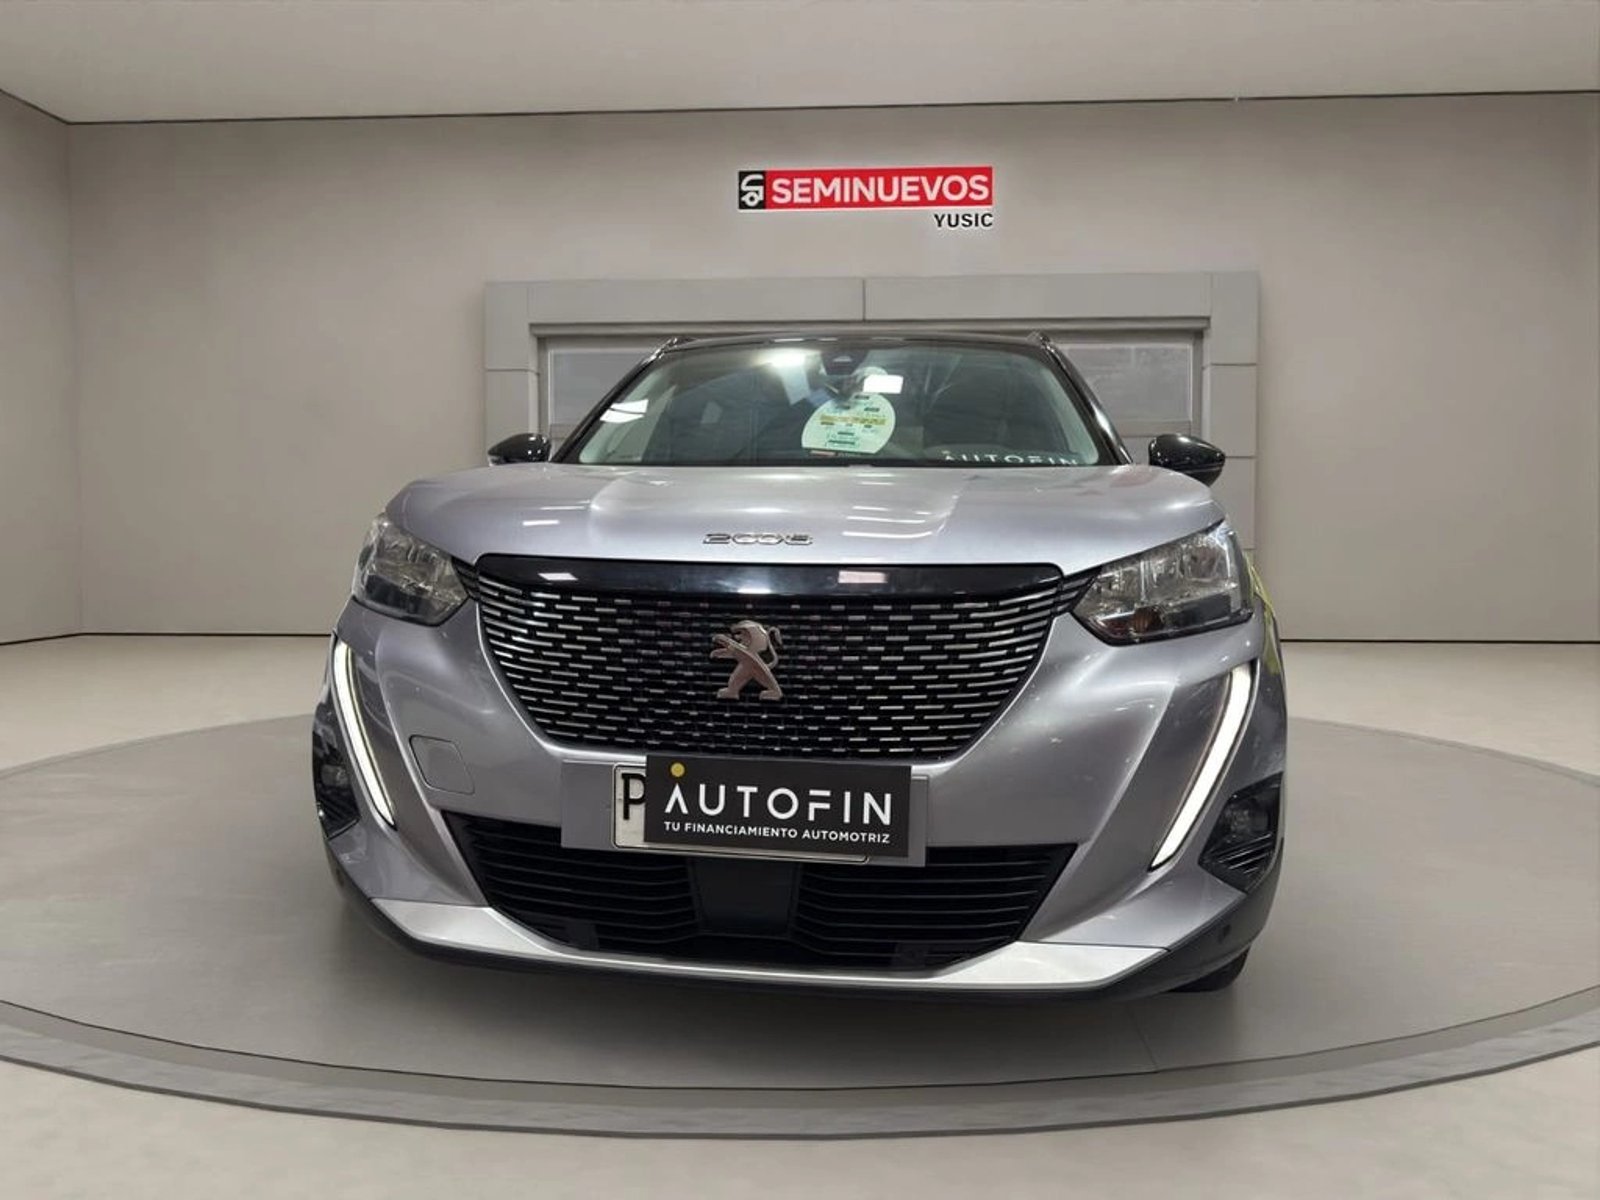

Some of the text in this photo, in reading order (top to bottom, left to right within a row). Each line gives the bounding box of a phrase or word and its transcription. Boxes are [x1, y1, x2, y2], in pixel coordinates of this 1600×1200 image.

[771, 174, 990, 204] SEMINUEVOS
[934, 213, 993, 228] YUSIC
[663, 782, 892, 825] AUTOFIN
[664, 821, 890, 844] TU FINANCIAMIENTO AUTOMOTRIZ
